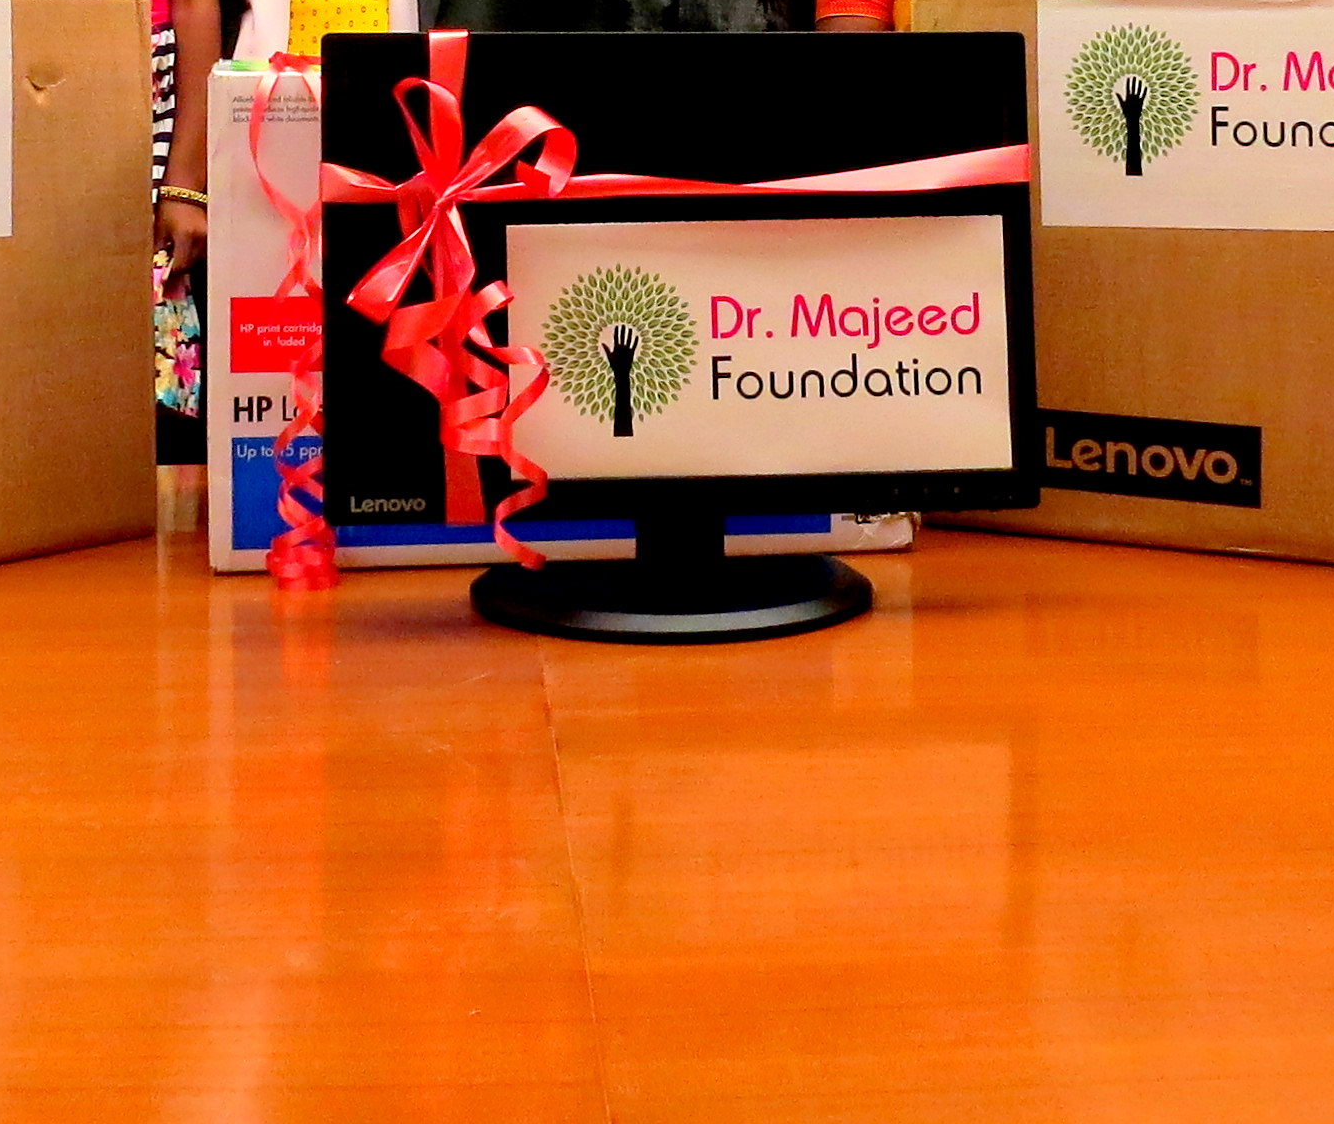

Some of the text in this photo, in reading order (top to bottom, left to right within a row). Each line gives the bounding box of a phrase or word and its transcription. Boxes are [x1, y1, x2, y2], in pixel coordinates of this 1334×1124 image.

[1210, 51, 1269, 93] Dr.
[240, 324, 254, 333] HP
[257, 323, 280, 336] print
[709, 291, 981, 350] Dr. Majeed
[263, 336, 306, 347] inluded
[710, 353, 983, 401] Foundation
[233, 395, 273, 422] HP
[236, 444, 257, 462] Up
[261, 444, 274, 456] to
[1045, 426, 1238, 485] Lenovo
[350, 496, 426, 513] Lenovo
